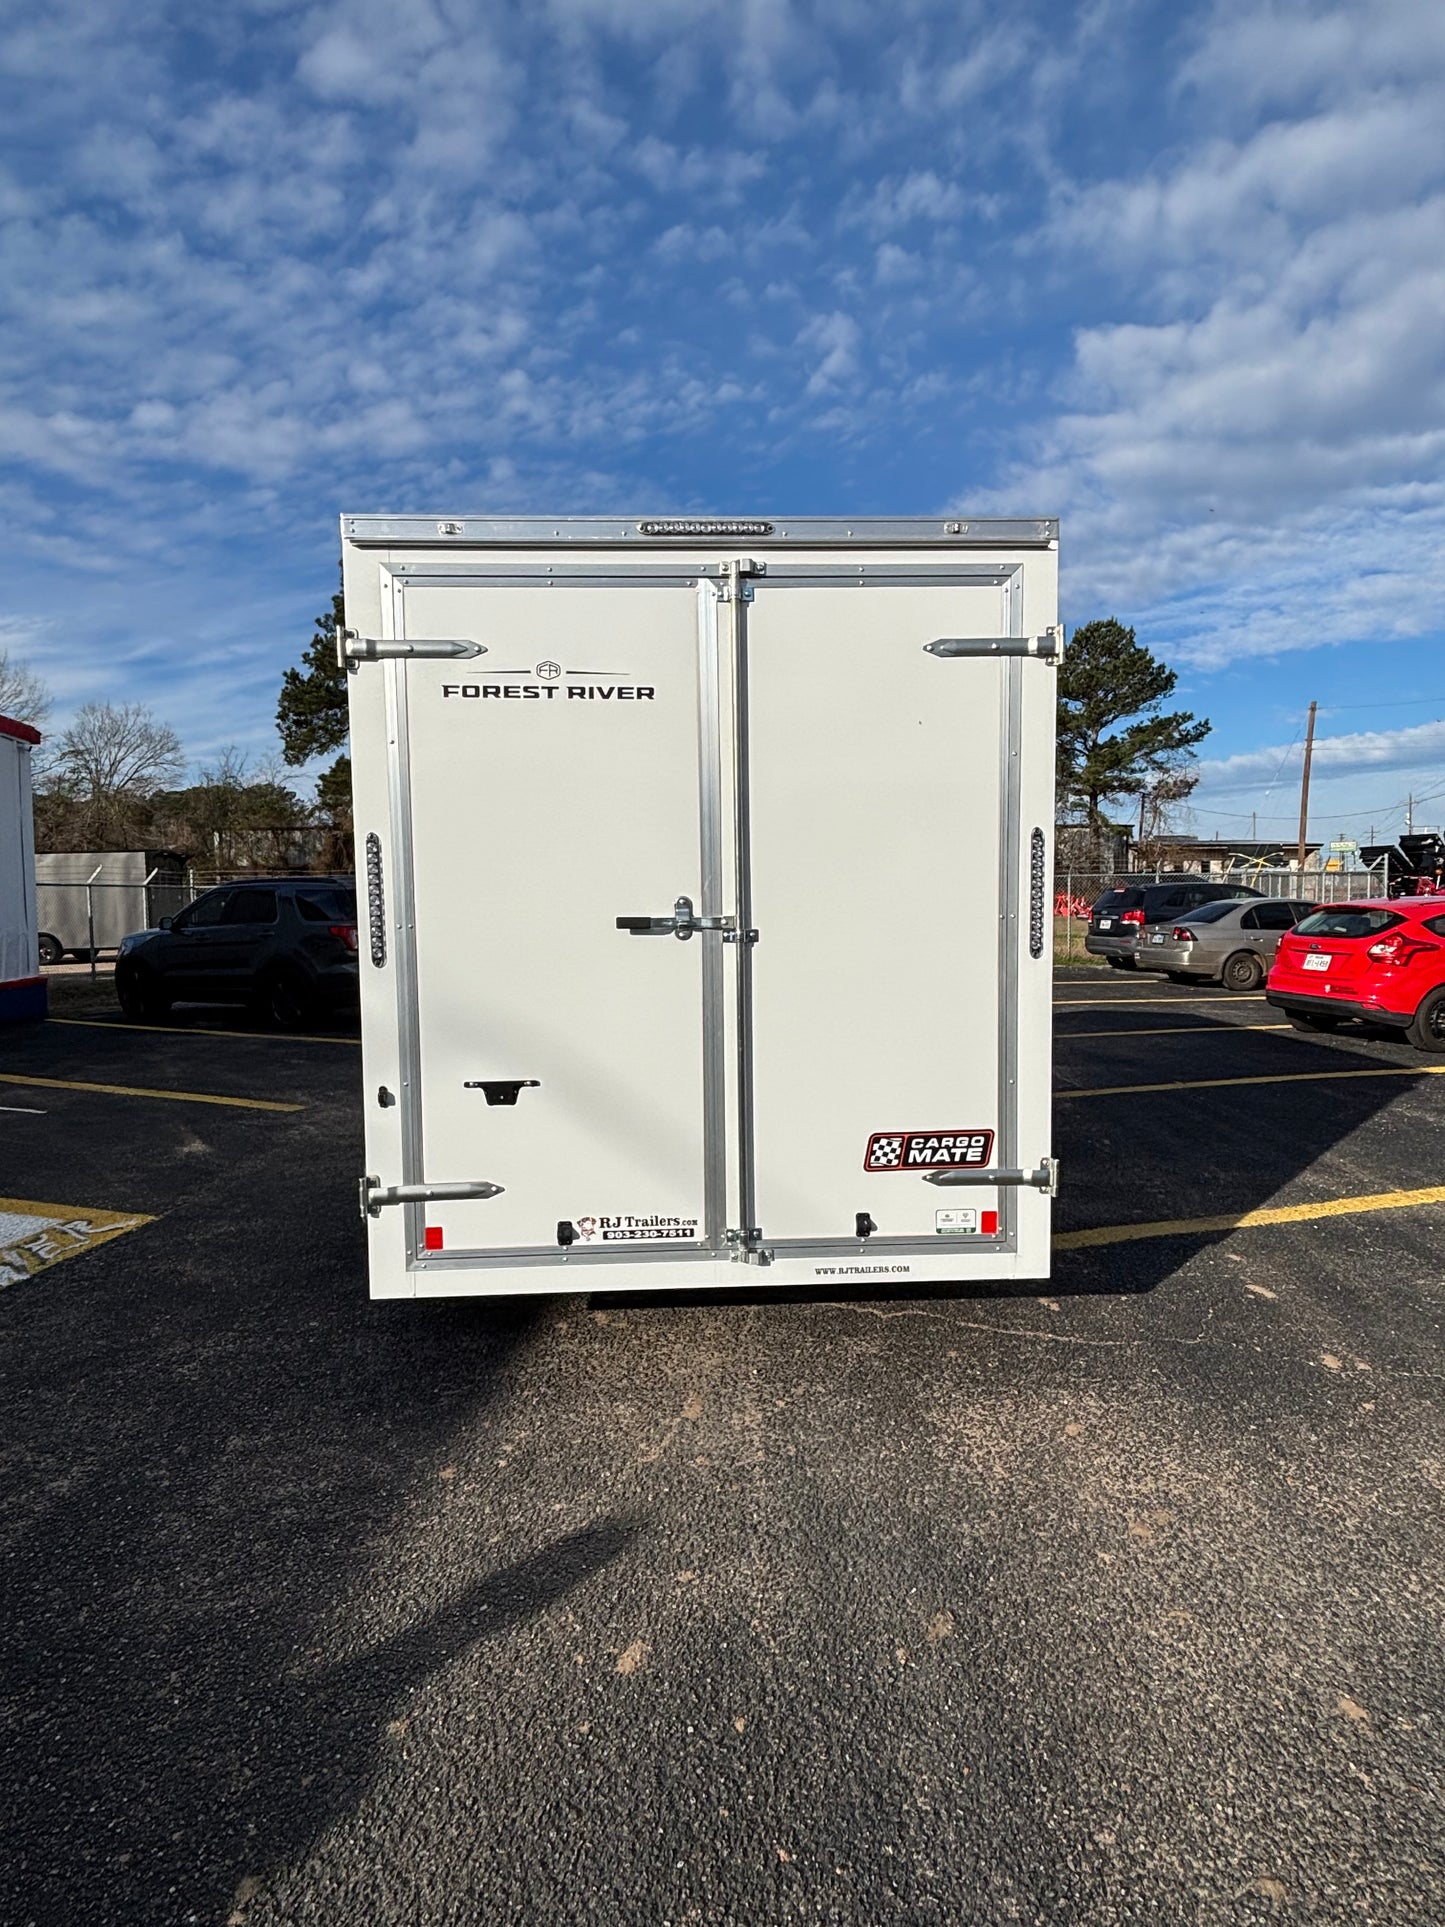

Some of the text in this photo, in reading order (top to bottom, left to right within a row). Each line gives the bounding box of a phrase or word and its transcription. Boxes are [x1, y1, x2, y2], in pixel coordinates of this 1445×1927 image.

[441, 685, 655, 700] FOREST RIVER
[910, 1136, 985, 1148] CARGO
[908, 1148, 983, 1163] MATE
[606, 1229, 691, 1239] 903-230-7511
[815, 1265, 910, 1275] WWW.RJTRAILERS.COM
